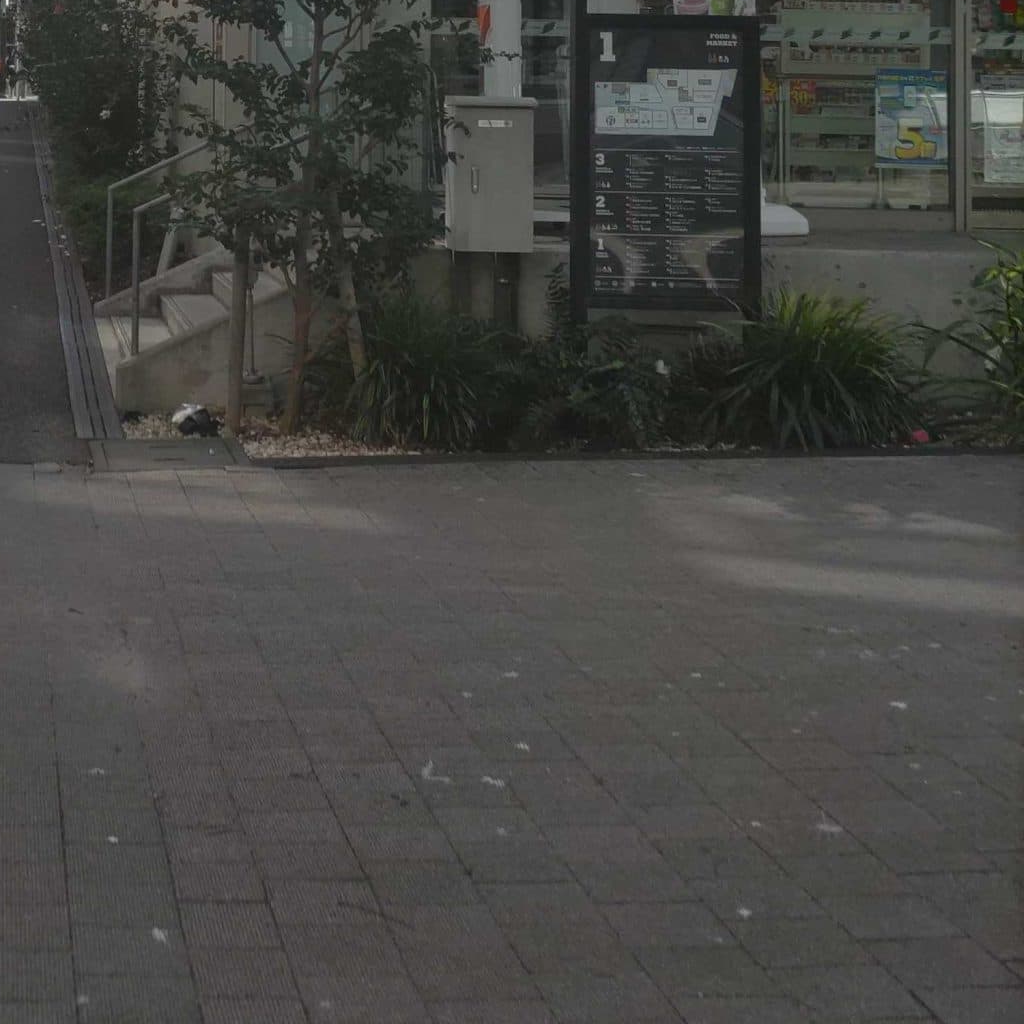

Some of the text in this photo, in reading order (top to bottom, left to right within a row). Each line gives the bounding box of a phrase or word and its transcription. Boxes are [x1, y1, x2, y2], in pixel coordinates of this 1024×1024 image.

[600, 32, 616, 62] 1
[595, 153, 606, 166] 3
[595, 196, 607, 208] 2
[596, 238, 605, 250] 1
